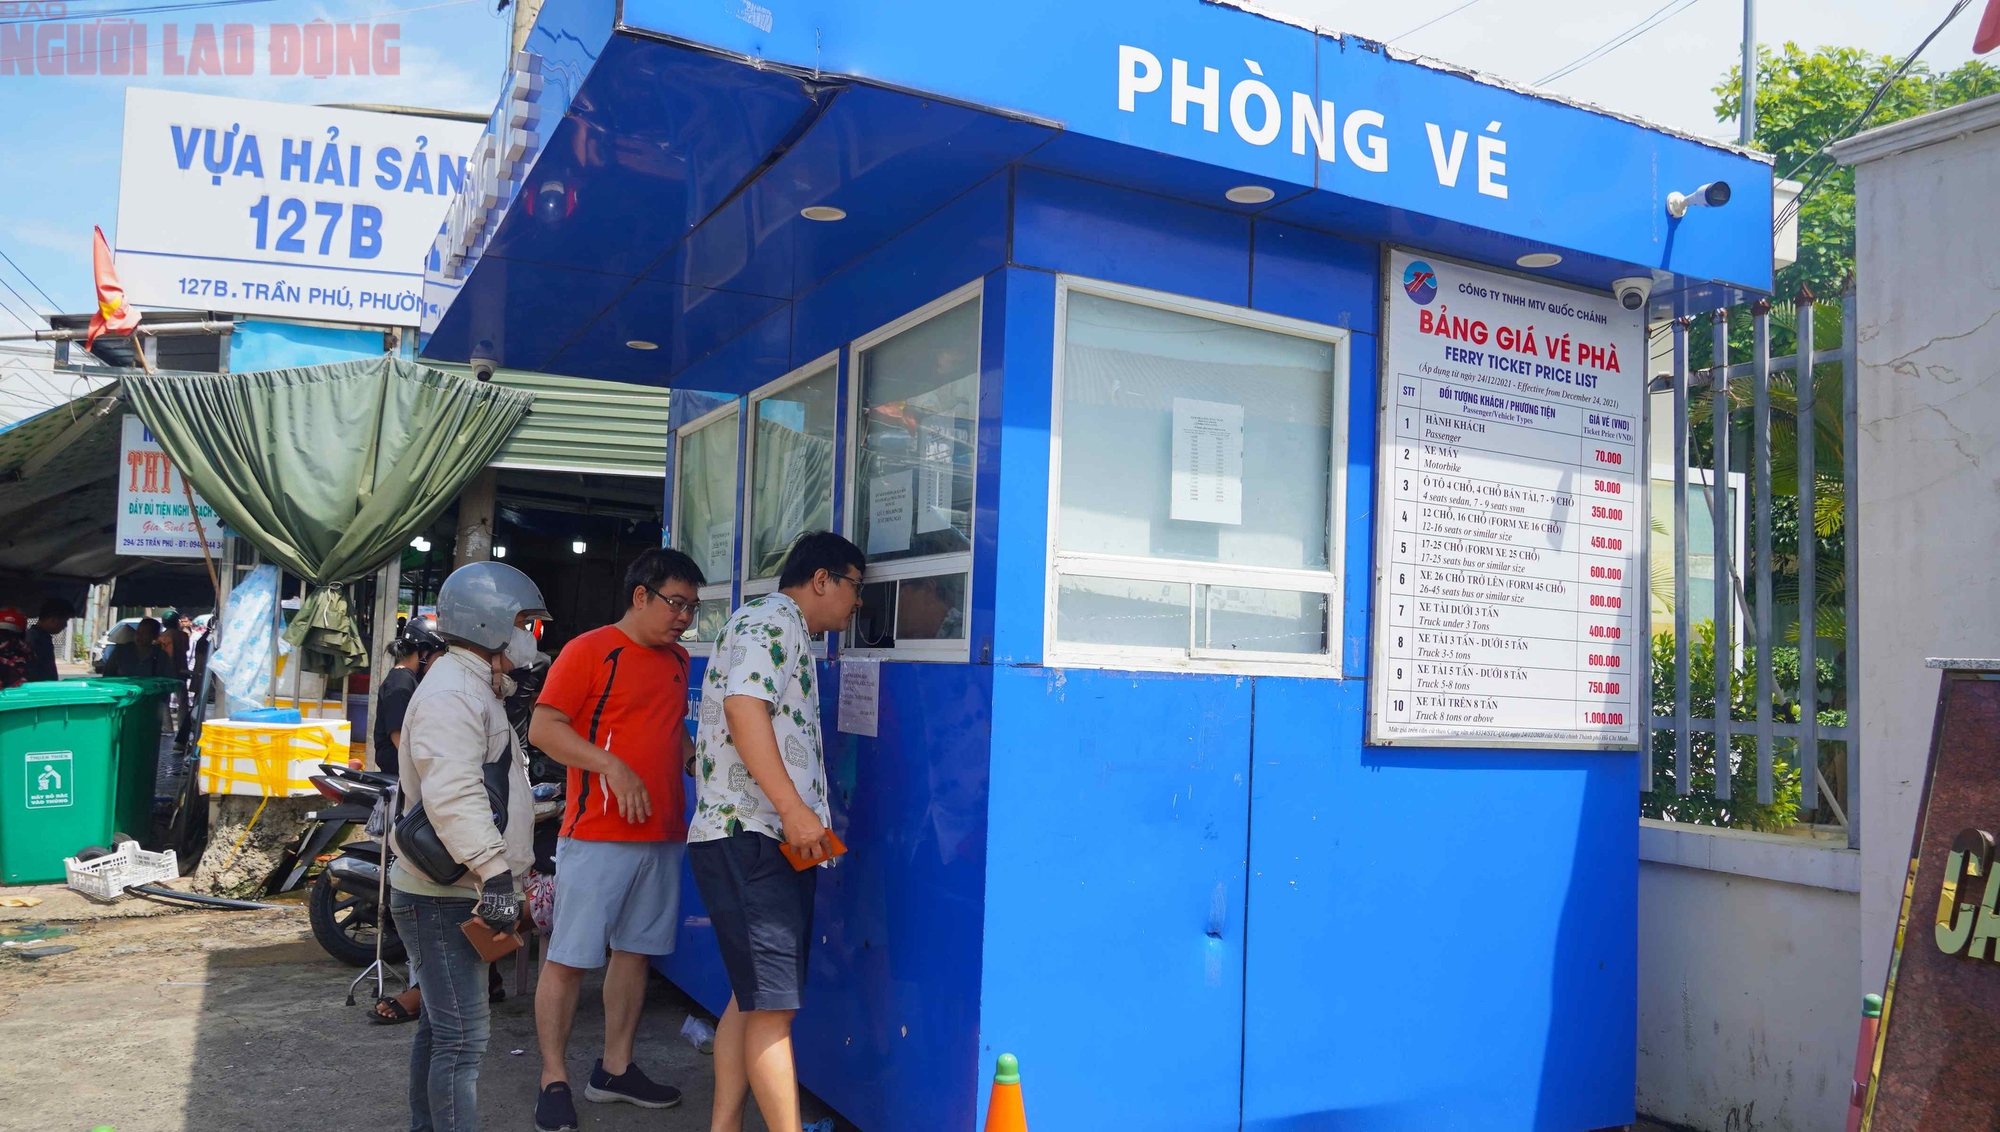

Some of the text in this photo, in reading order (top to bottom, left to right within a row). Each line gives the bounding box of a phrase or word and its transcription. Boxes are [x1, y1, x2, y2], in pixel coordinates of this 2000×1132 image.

[1118, 44, 1508, 199] PHÒNG VÉ
[170, 122, 467, 196] VỰA HẢI SẢN
[250, 195, 383, 260] 127B
[242, 280, 301, 303] TRẦN
[309, 286, 353, 310] PHÚ,
[1458, 282, 1607, 325] CÔNG TY TNHH MTV QUỐC CHÁNH
[1419, 304, 1621, 373] BẢNG GIÁ VÉ PHÀ
[1445, 346, 1598, 389] FERRY TICKET PRICE LIST
[1402, 385, 1415, 397] STT
[1432, 366, 1451, 379] dụng
[1460, 372, 1476, 383] ngày
[1477, 373, 1512, 388] 24/12/2021
[1517, 381, 1545, 395] Effective
[1544, 387, 1561, 397] from
[1561, 390, 1592, 403] December
[1439, 385, 1556, 420] ĐỐI TƯỢNG KHÁCH PHƯƠNG TIỆN
[1405, 417, 1409, 429] 1
[1425, 413, 1485, 433] HÀNH KHÁCH
[1462, 405, 1533, 425] Passenger/Vehicle Types
[1589, 413, 1629, 432] GIÁ VÉ (VND)
[1425, 428, 1462, 444] Passenger
[1583, 426, 1633, 443] Ticket Price (VND)
[1404, 448, 1410, 460] 2
[1424, 444, 1459, 459] XE MÁY
[1595, 449, 1622, 465] 70.000
[1423, 458, 1462, 473] Motorbike
[1403, 479, 1409, 491] 3
[1423, 475, 1431, 487] Ô
[1432, 477, 1445, 489] TÔ
[1446, 481, 1451, 489] 4
[1476, 485, 1481, 494] 4
[1482, 484, 1502, 497] CHỖ
[1503, 488, 1520, 499] BÁN
[1540, 494, 1545, 502] 7
[1550, 496, 1555, 504] 9
[1556, 494, 1575, 507] CHỖ
[1594, 479, 1621, 495] 50.000
[1422, 491, 1428, 500] 4
[1429, 494, 1448, 503] seats
[1474, 498, 1479, 507] 7
[1484, 499, 1490, 509] 9
[1490, 503, 1508, 511] seats
[173, 504, 189, 516] NGHI
[1402, 510, 1408, 523] 4
[1591, 505, 1623, 521] 350.000
[1423, 508, 1432, 517] 12
[1458, 512, 1466, 521] 16
[1467, 512, 1487, 524] CHỖ
[1518, 520, 1529, 530] XE
[1532, 522, 1540, 531] 16
[1422, 521, 1443, 533] 12-16
[1444, 526, 1462, 535] seats
[1473, 528, 1498, 539] similar
[1498, 531, 1513, 542] size
[1400, 541, 1407, 554] 5
[1590, 536, 1622, 551] 450.000
[1399, 573, 1405, 585] 6
[1420, 570, 1432, 580] XE
[1434, 571, 1444, 581] 26
[1445, 570, 1465, 583] CHỖ
[1487, 575, 1504, 587] LÊN
[1535, 582, 1544, 592] 45
[1590, 565, 1622, 581] 600.000
[1590, 594, 1622, 609] 800.000
[1398, 604, 1404, 617] 7
[1419, 602, 1432, 612] XE
[1451, 604, 1473, 616] DƯỚI
[1474, 607, 1480, 616] 3
[1481, 604, 1499, 618] TẤN
[1589, 625, 1621, 639] 400.000
[1398, 636, 1404, 648] 8
[1588, 654, 1620, 668] 600.000
[1397, 668, 1403, 680] 9
[1588, 681, 1620, 695] 750.000
[1394, 700, 1404, 712] 10
[1416, 696, 1428, 706] XE
[1448, 696, 1472, 708] TRÊN
[1473, 700, 1479, 709] 8
[1480, 697, 1498, 709] TẤN
[1416, 710, 1438, 721] Truck
[1439, 711, 1445, 721] 8
[1446, 713, 1462, 722] tons
[1472, 713, 1494, 723] above
[1584, 712, 1623, 725] 1.000.000
